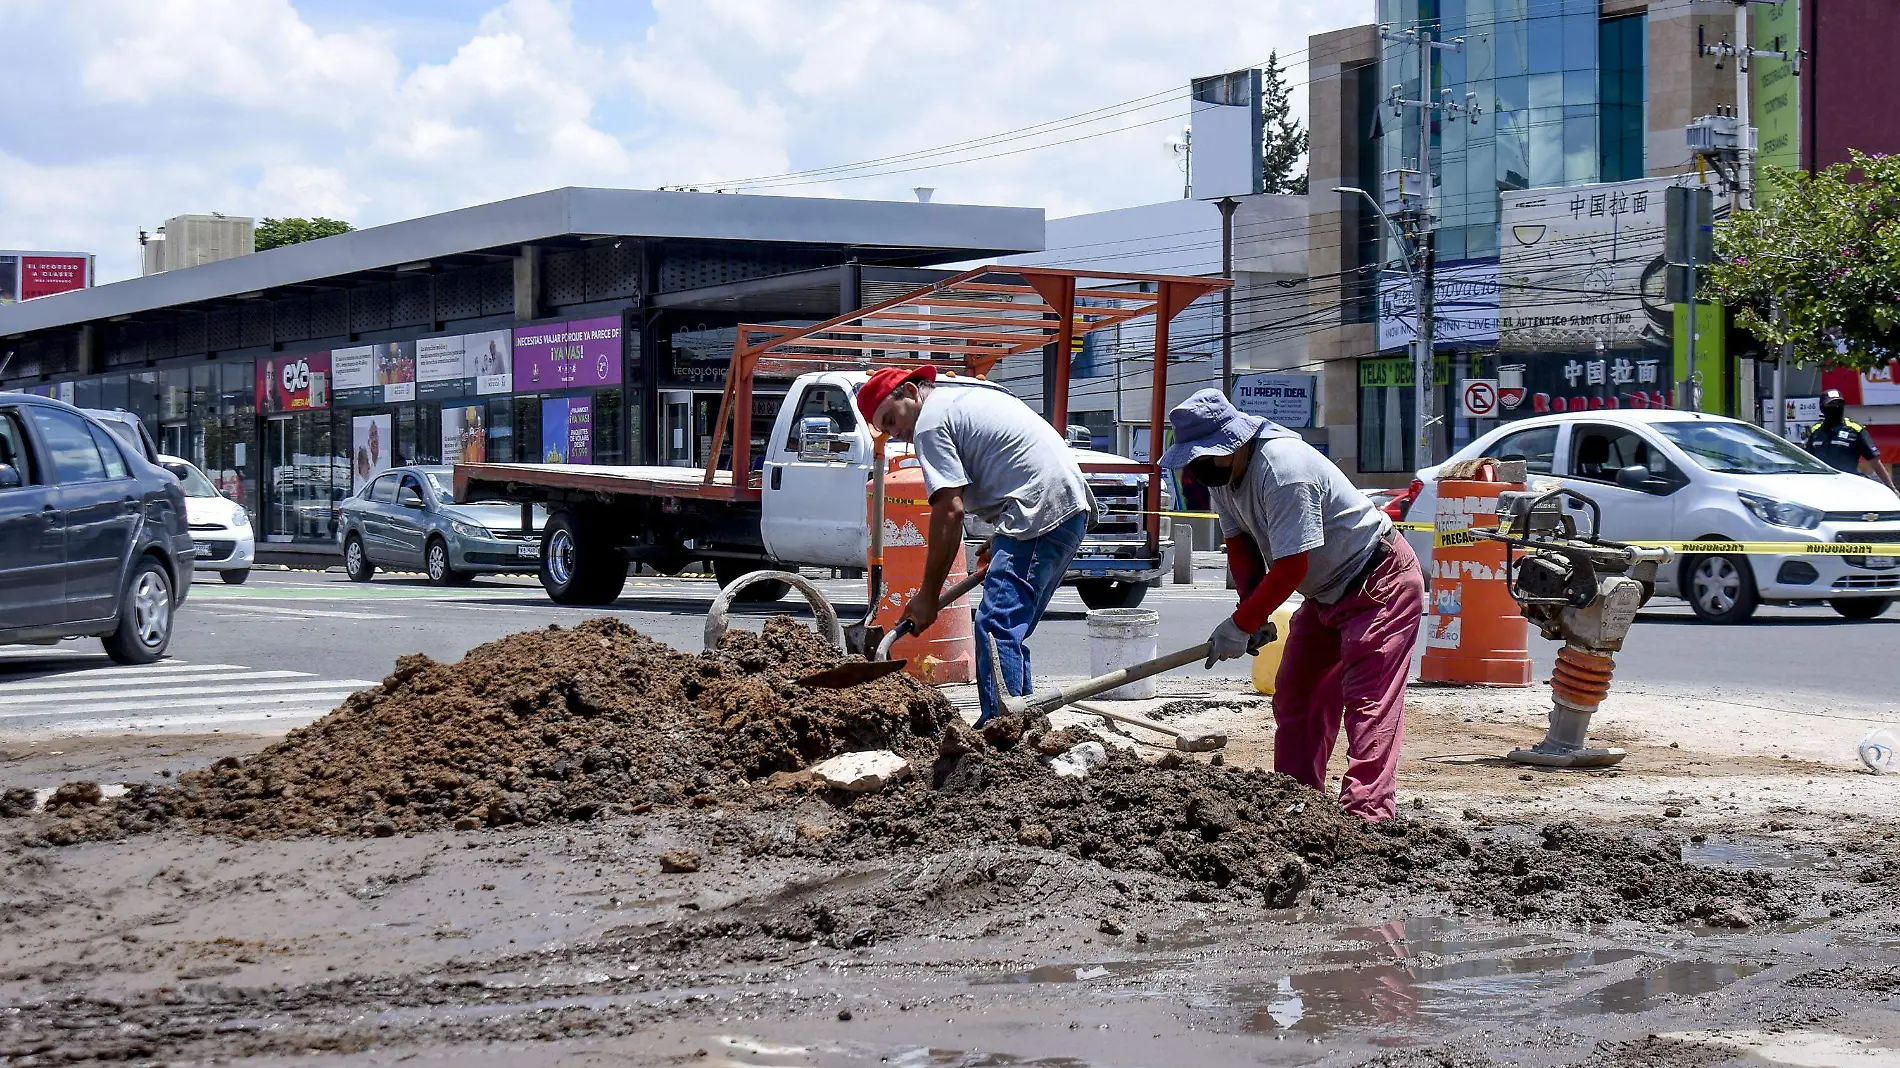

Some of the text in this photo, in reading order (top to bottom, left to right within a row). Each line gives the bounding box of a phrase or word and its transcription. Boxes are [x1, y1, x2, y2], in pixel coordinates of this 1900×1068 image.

[1570, 189, 1649, 220] 中国拉面
[1503, 316, 1514, 327] EL
[543, 332, 561, 344] VIAJAR
[561, 331, 583, 343] PORQUE
[583, 330, 591, 341] YA
[591, 328, 611, 340] PARECE
[283, 359, 310, 393] exa
[1362, 362, 1387, 384] TELAS
[1565, 359, 1660, 387] 中国拉面
[1240, 387, 1307, 398] TU PREPA IDEAL
